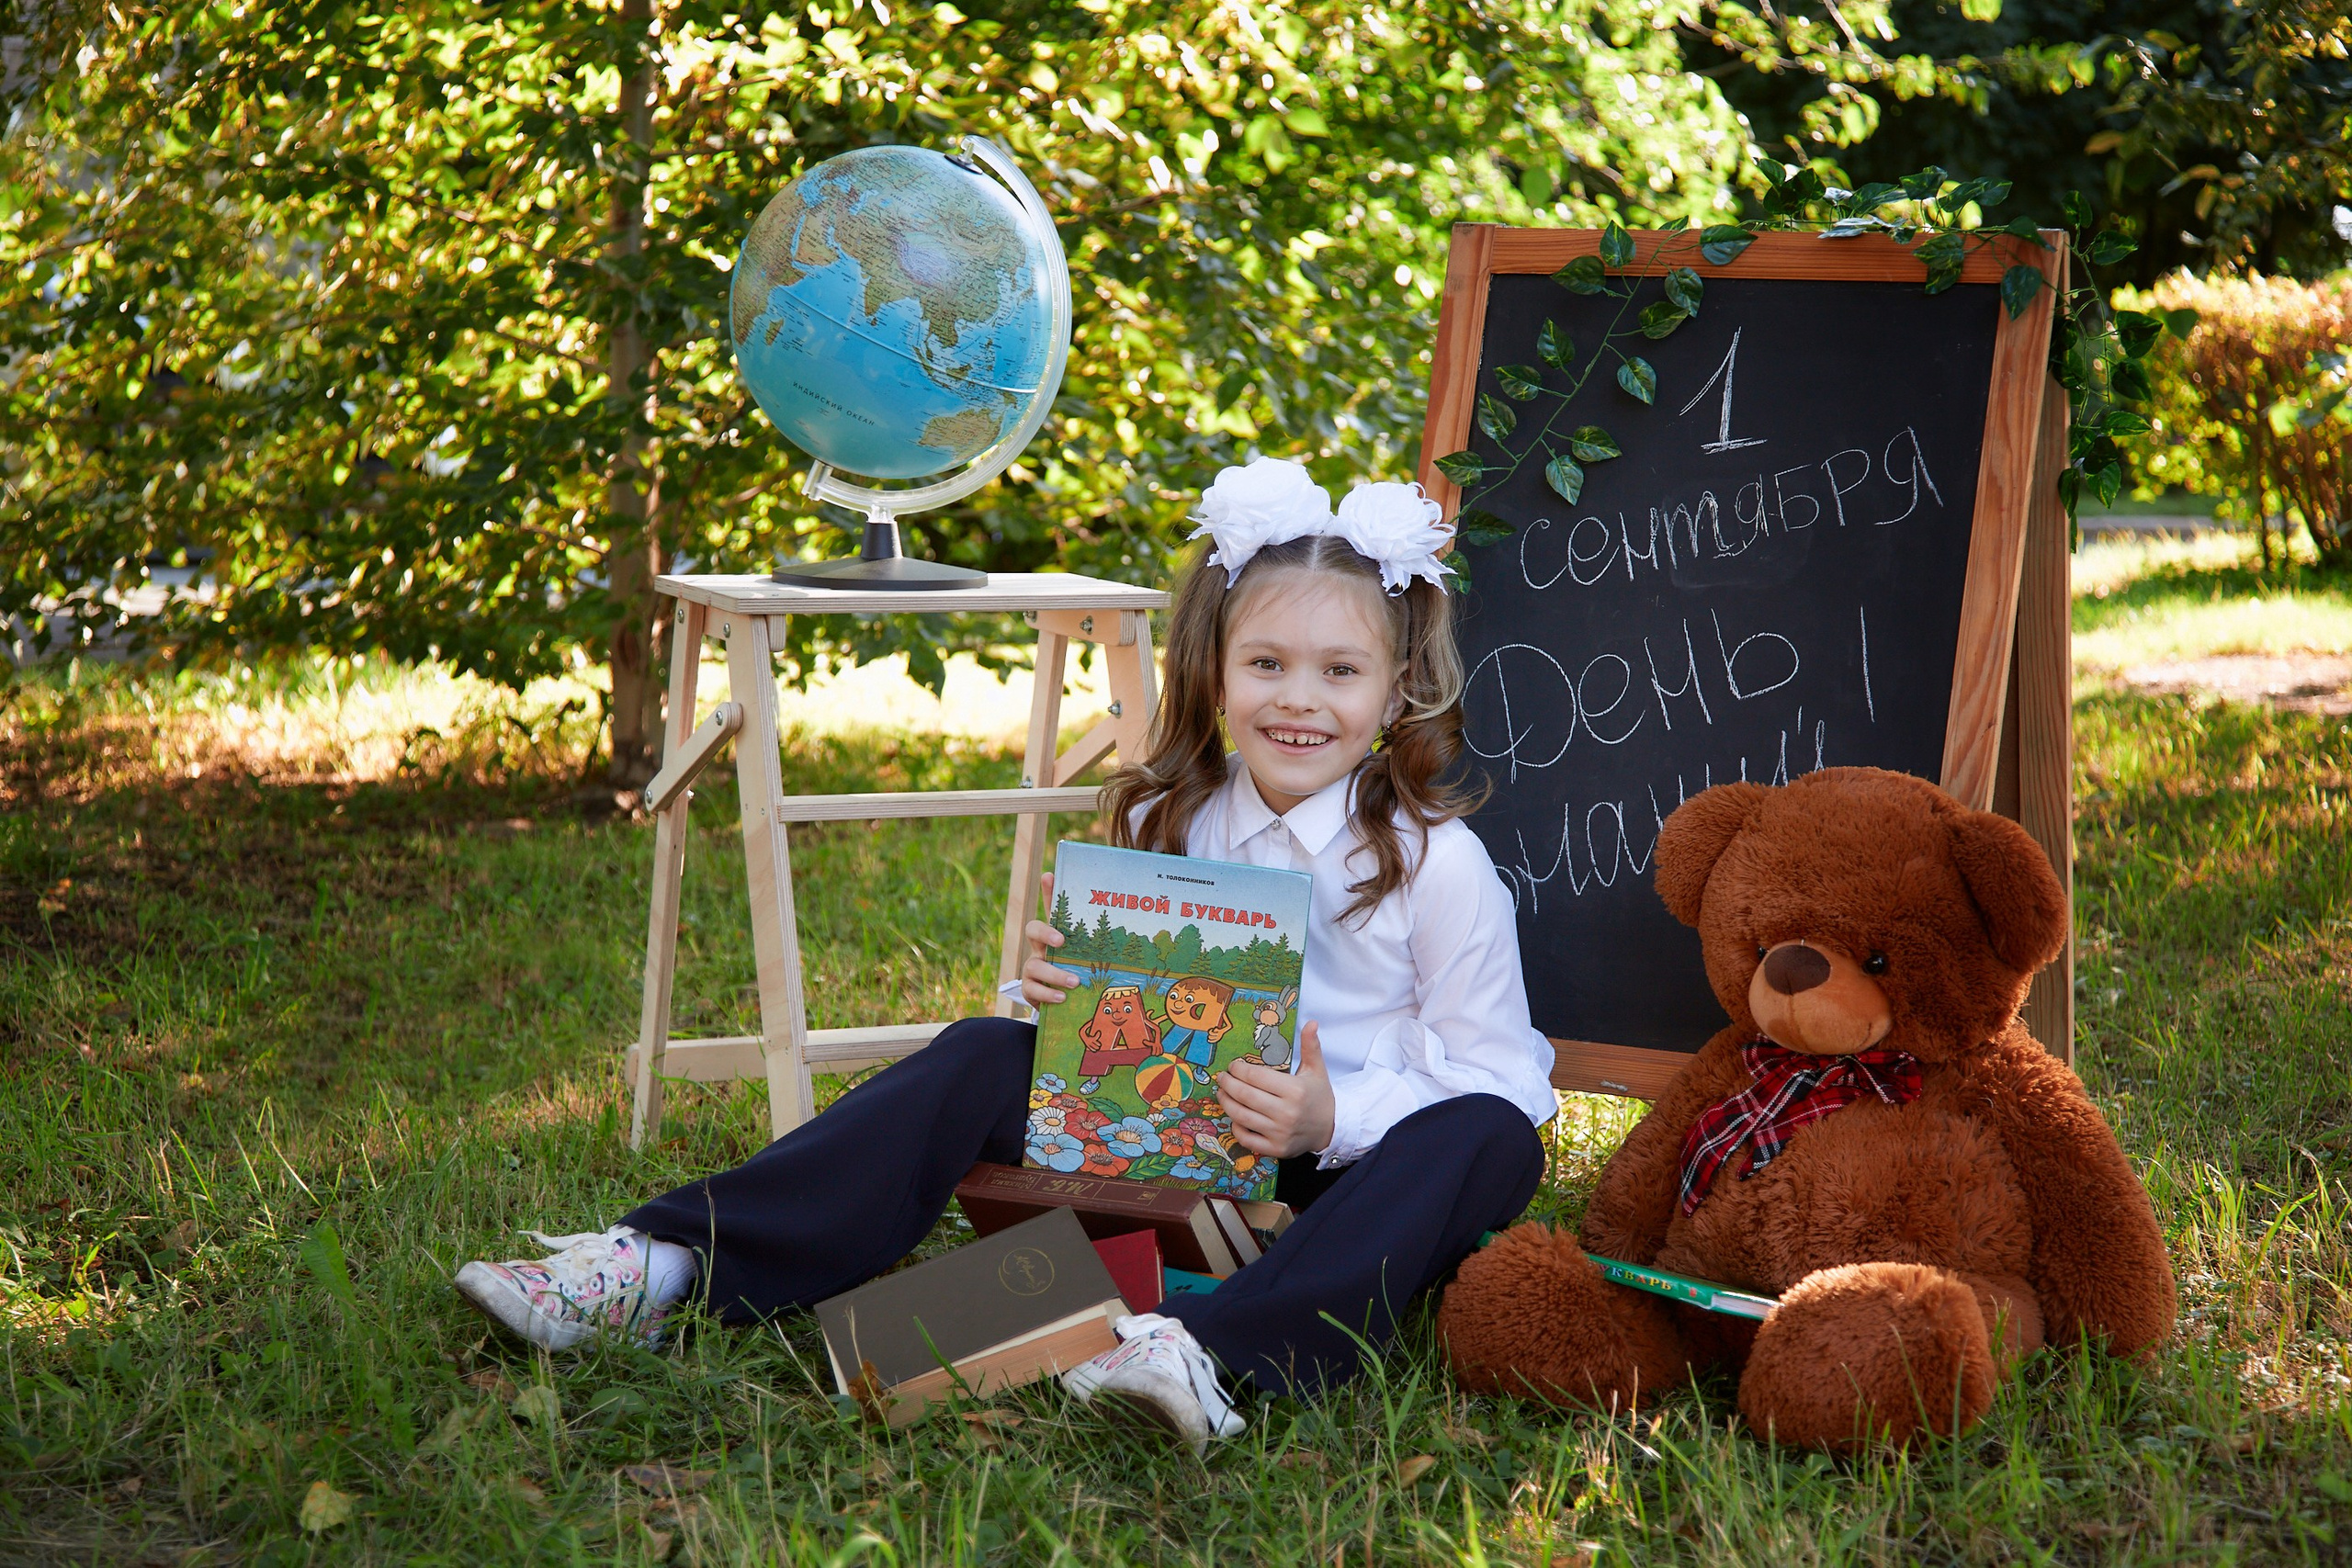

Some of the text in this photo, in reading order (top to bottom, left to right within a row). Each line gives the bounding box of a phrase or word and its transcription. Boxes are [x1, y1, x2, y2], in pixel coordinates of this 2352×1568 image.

[793, 381, 876, 426] ИНДИЙСКИЙ ОКЕАН
[1679, 325, 1768, 456] 1
[1165, 874, 1216, 886] ТОЛОКОННИКОВ
[1088, 888, 1278, 930] ЖИВОЙ БУКВАРЬ
